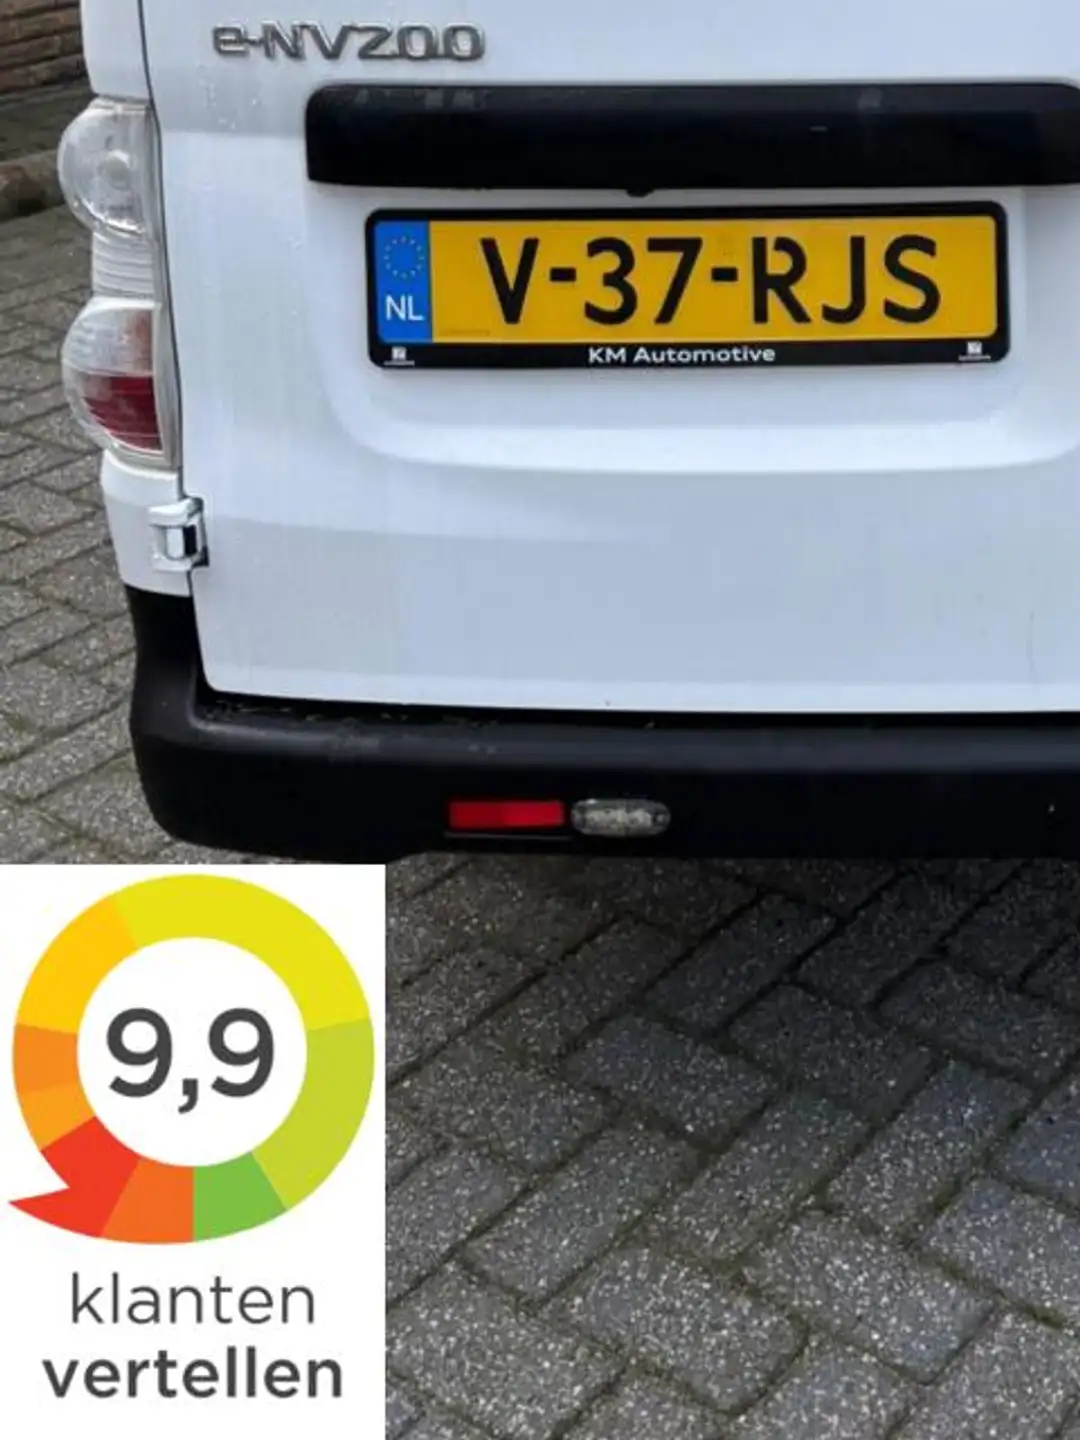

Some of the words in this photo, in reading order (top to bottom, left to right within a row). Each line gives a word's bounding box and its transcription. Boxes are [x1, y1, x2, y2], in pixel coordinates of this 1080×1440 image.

[212, 20, 486, 61] e-NV200
[479, 234, 942, 326] V-37-RJS
[385, 294, 424, 321] NL
[588, 346, 627, 363] KM
[633, 344, 776, 363] Automotive
